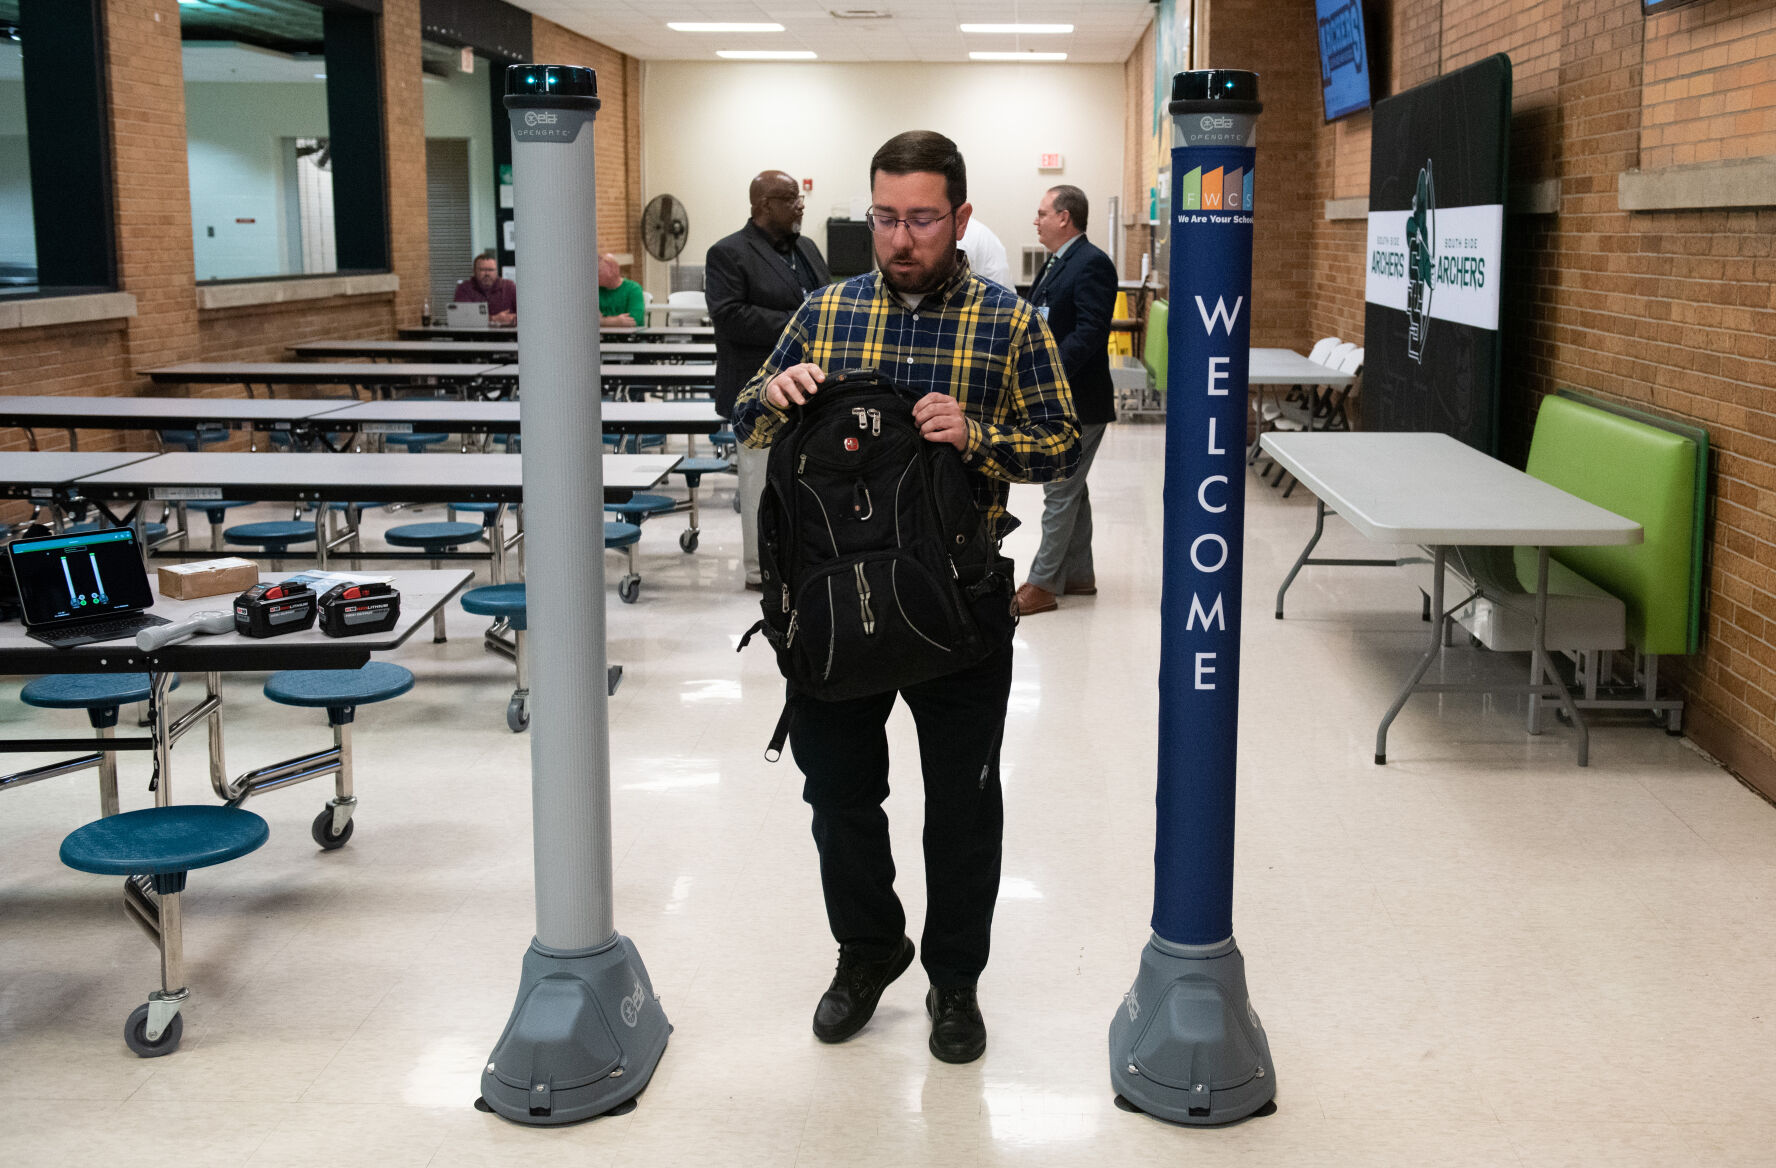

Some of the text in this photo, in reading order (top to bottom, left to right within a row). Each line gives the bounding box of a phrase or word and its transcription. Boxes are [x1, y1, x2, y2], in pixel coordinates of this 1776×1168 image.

[1178, 214, 1190, 223] We
[1190, 214, 1208, 223] Are
[1209, 215, 1232, 223] Your
[1444, 238, 1478, 249] SOUTH SIDE
[1371, 250, 1405, 280] ARCHERS
[1436, 255, 1486, 292] ARCHERS
[1185, 294, 1244, 690] WELCOME
